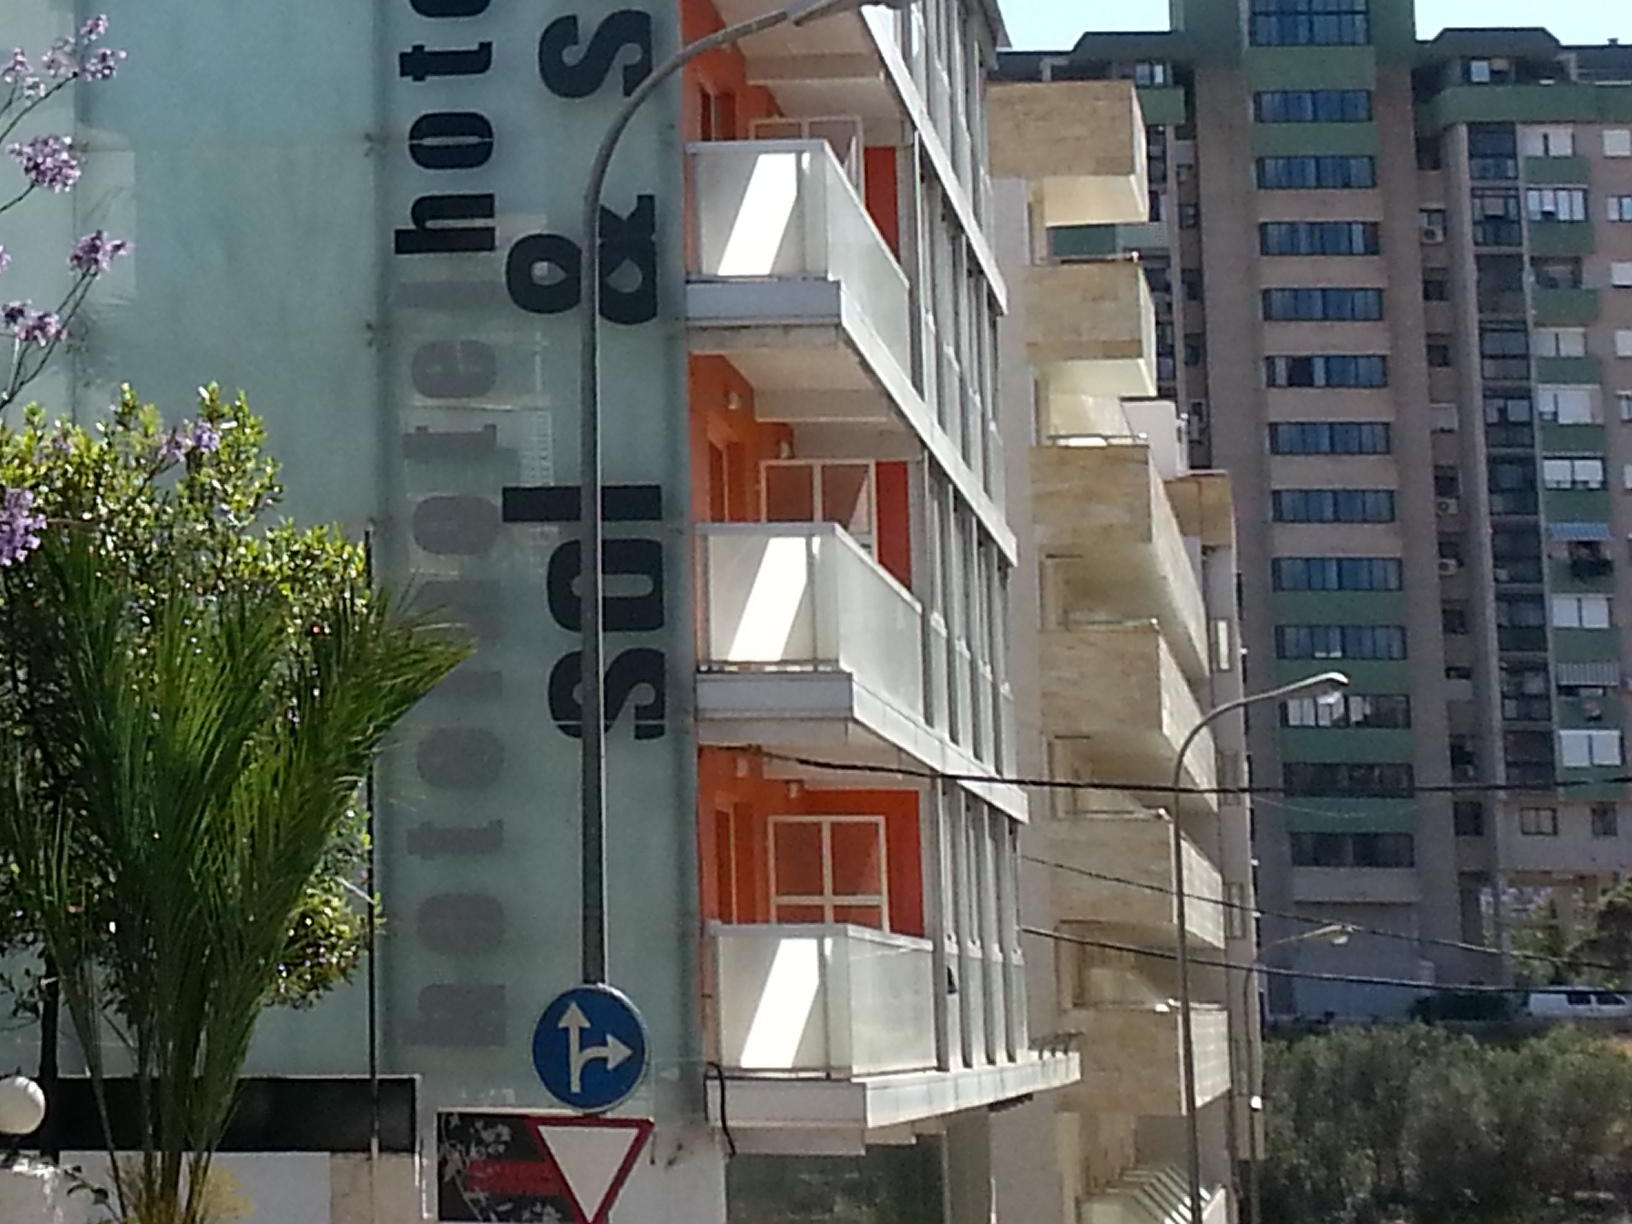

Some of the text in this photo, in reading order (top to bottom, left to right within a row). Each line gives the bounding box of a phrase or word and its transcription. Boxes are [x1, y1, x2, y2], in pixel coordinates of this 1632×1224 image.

[504, 193, 659, 326] &
[394, 278, 502, 642] hotel
[501, 484, 667, 741] sol
[403, 669, 507, 1048] hotel
